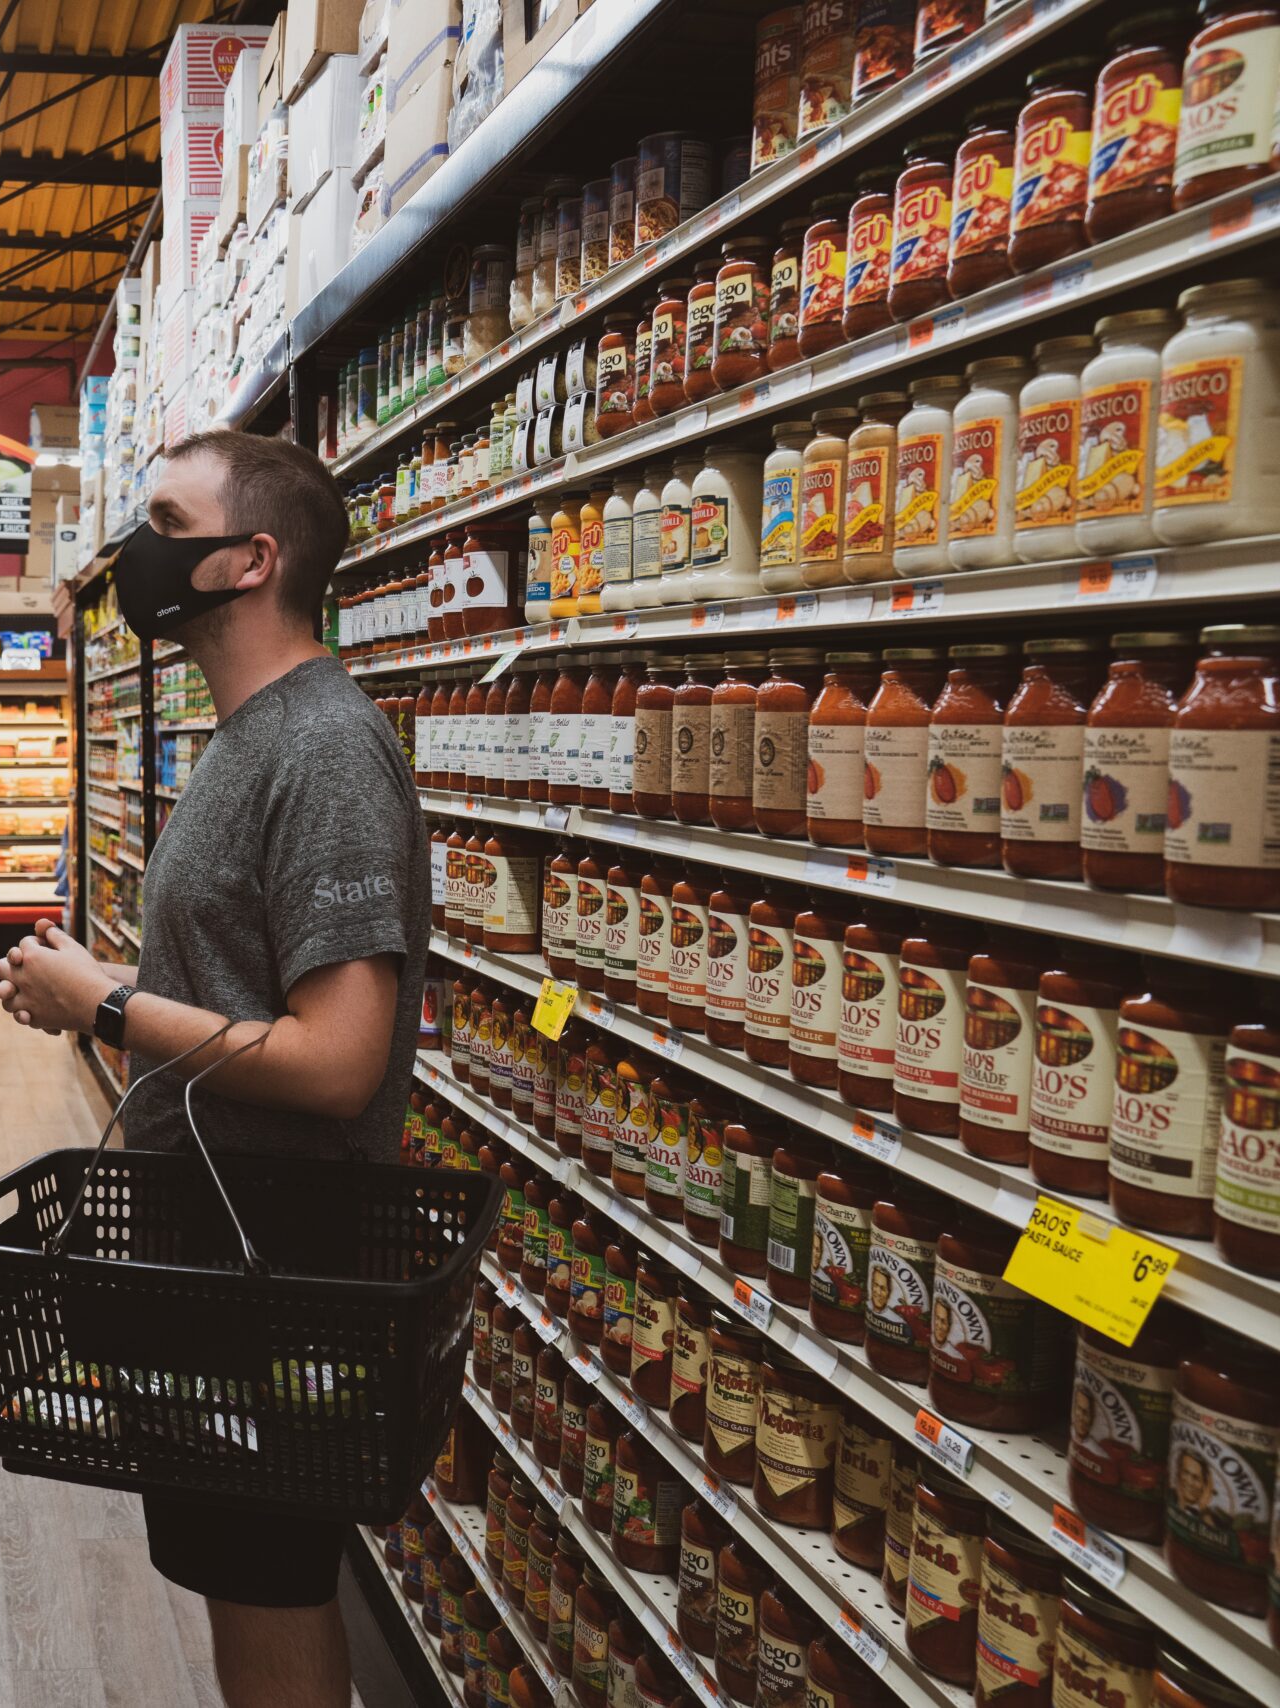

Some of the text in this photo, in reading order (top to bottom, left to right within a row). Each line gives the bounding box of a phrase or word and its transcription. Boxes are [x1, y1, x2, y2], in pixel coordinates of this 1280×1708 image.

[3, 524, 27, 532] SAUCE
[157, 605, 180, 617] atoms
[676, 984, 696, 993] SAUCE
[753, 1014, 781, 1025] GARLIC
[795, 1029, 824, 1042] GARLIC
[1045, 1115, 1105, 1137] MARINARA
[825, 1204, 856, 1222] Charity
[1030, 1208, 1071, 1237] RAO'S
[827, 1234, 848, 1268] OWN
[894, 1240, 933, 1257] Charity
[1022, 1228, 1084, 1263] PASTA SAUCE
[898, 1272, 923, 1306] OWN
[954, 1271, 996, 1290] Charity
[958, 1303, 985, 1342] OWN
[713, 1384, 755, 1404] Organic
[785, 1464, 816, 1477] GARLIC
[1220, 1457, 1261, 1511] OWN
[765, 1669, 793, 1687] Sausage
